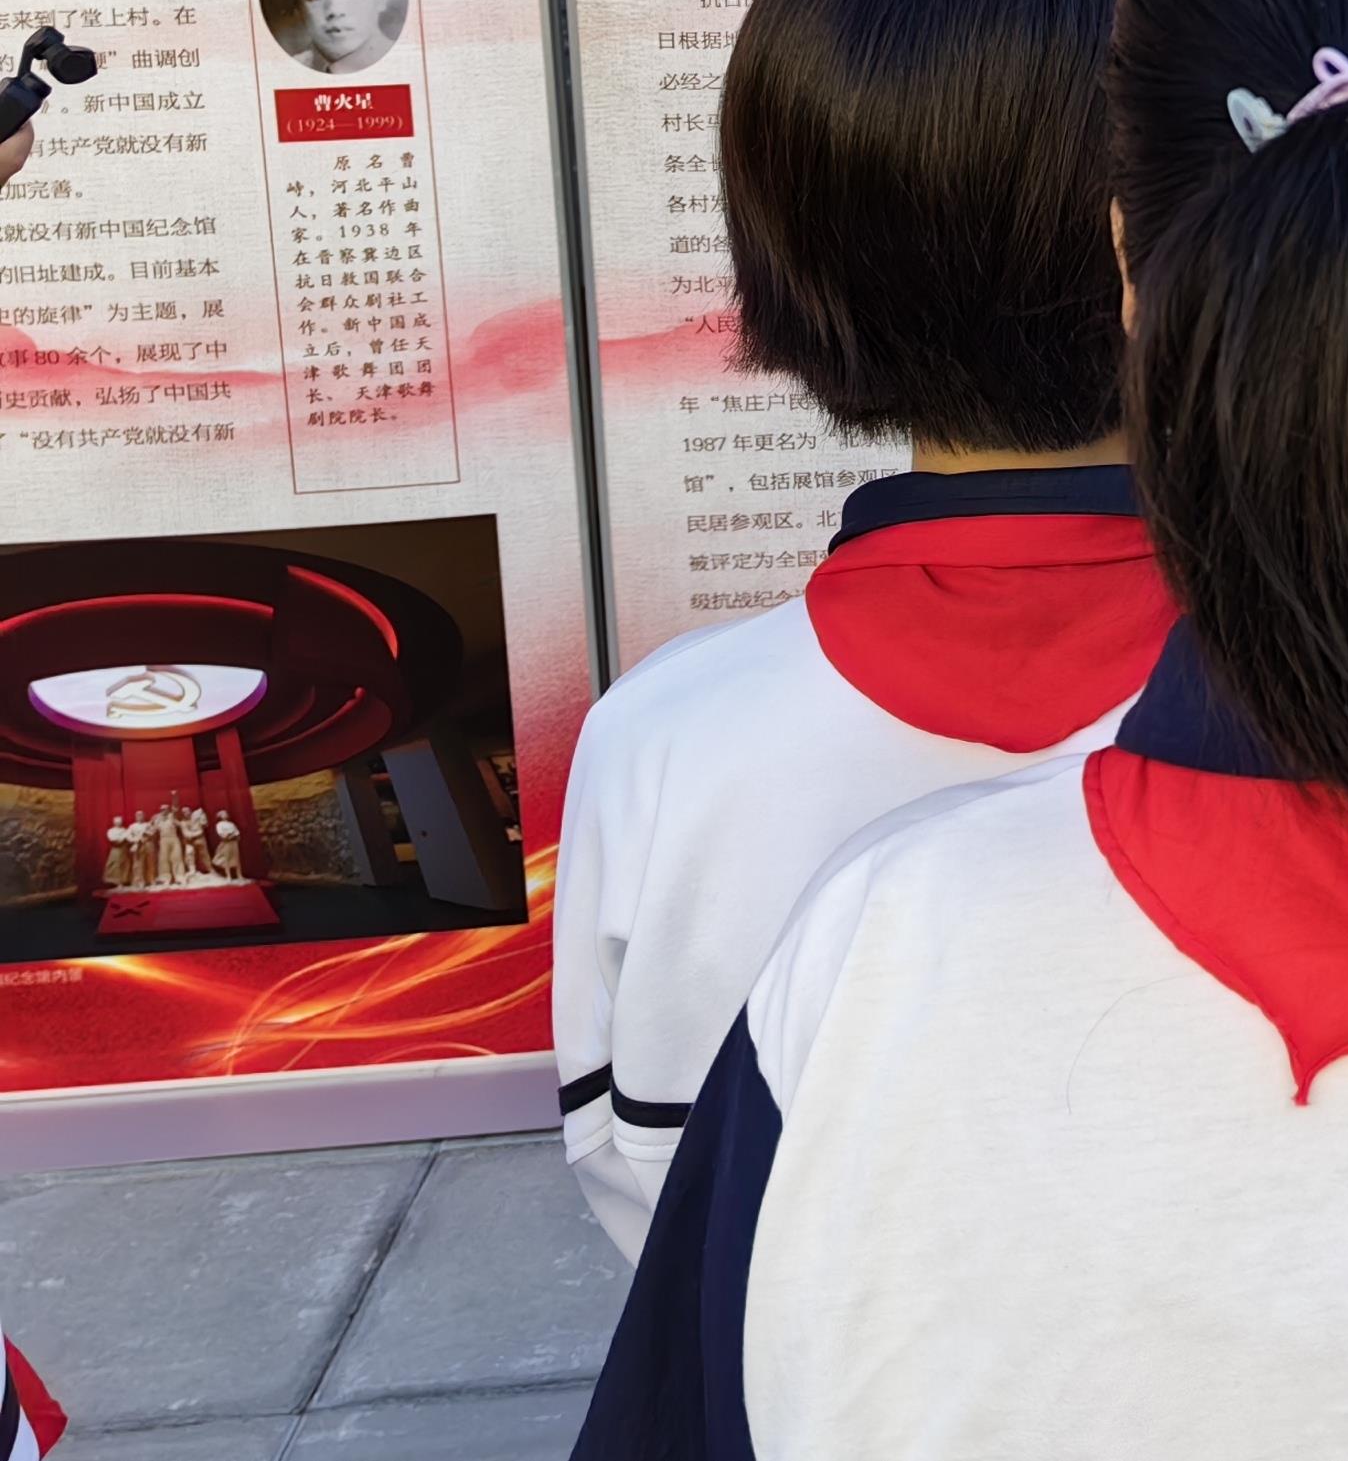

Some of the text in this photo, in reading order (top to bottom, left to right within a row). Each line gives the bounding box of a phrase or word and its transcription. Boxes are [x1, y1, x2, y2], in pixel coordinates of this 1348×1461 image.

[313, 94, 374, 111] 曹火星
[0, 216, 217, 243] 就没有新中国纪念馆
[295, 269, 428, 290] 抗日救国联合
[0, 381, 232, 409] 史贡献，弘扬了中国共
